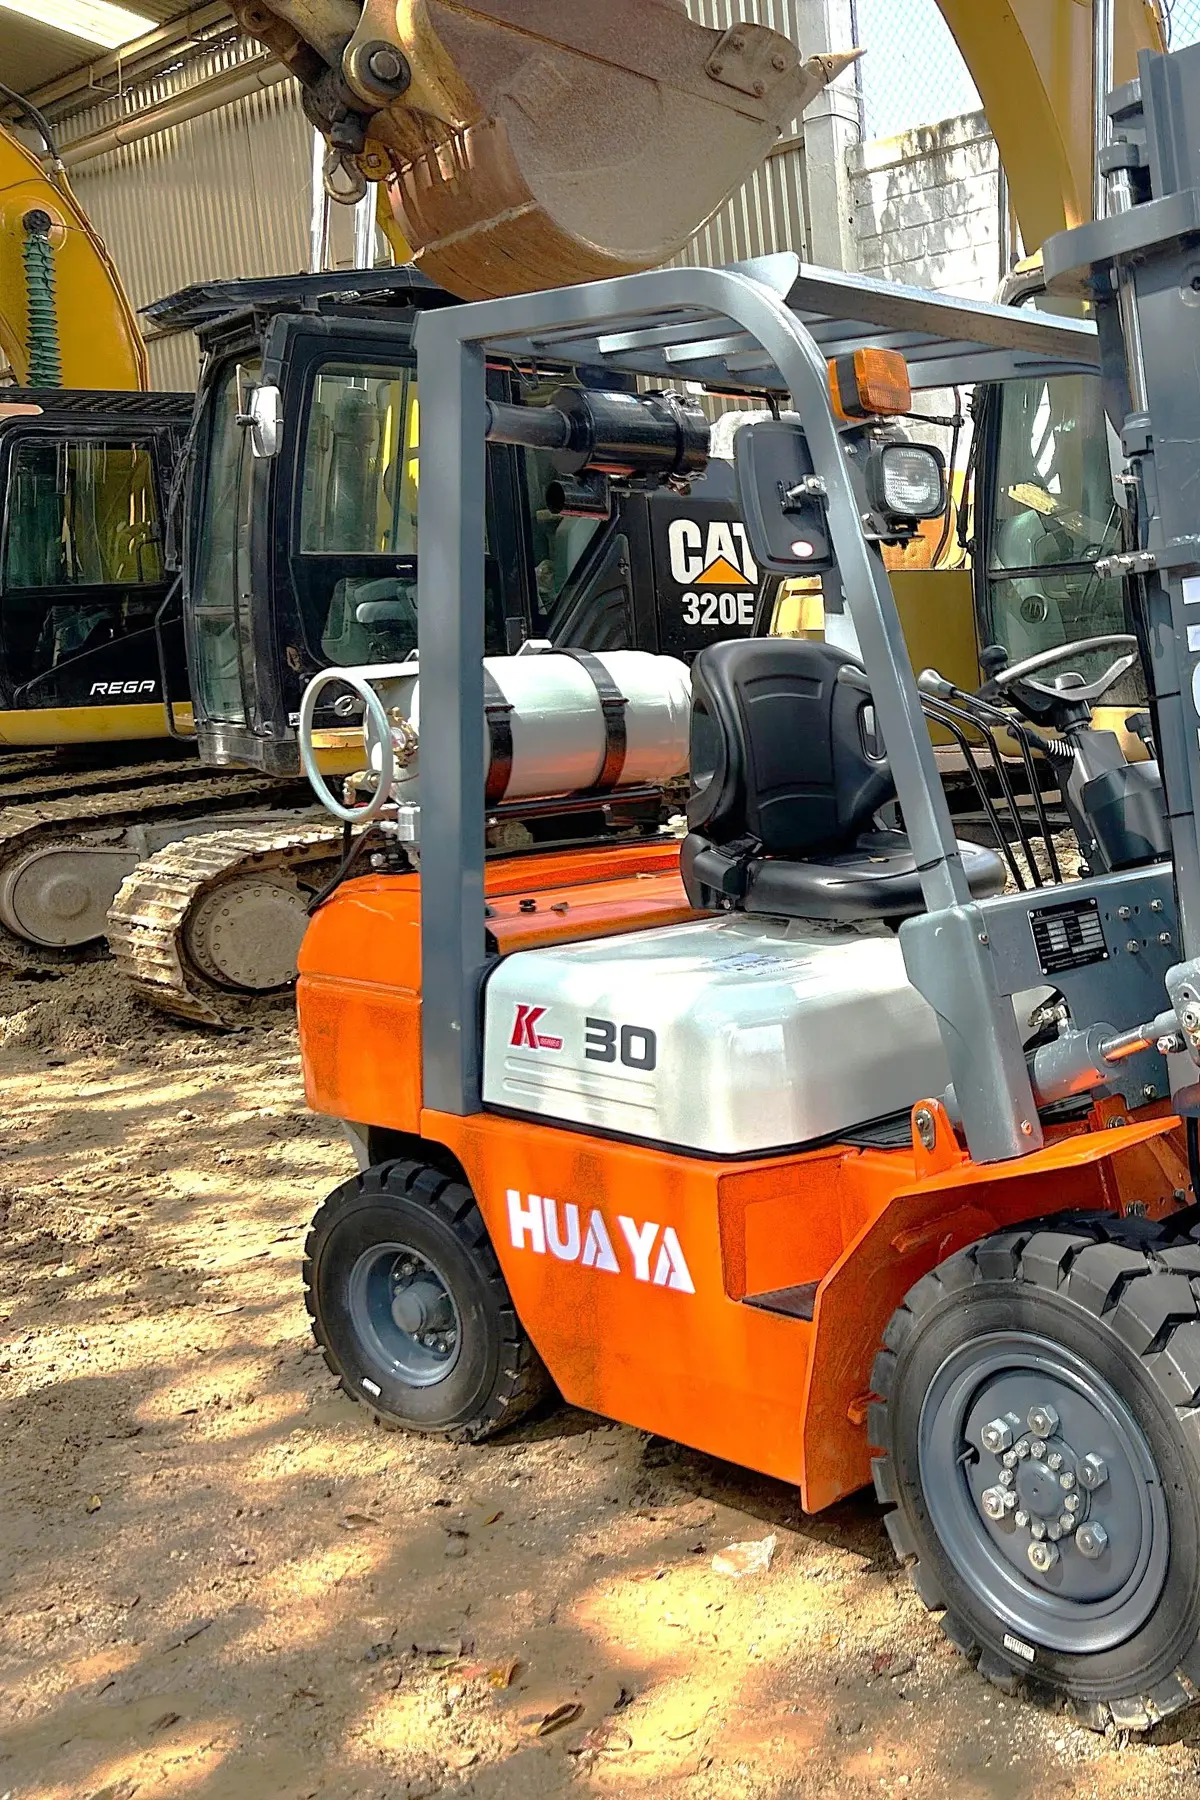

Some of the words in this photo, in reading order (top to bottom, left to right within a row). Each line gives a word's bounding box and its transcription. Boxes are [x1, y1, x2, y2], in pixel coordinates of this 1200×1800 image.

[668, 519, 759, 585] CAT
[682, 592, 754, 625] 320E
[89, 680, 156, 696] REGA
[509, 1002, 551, 1051] K
[585, 1016, 657, 1072] 30
